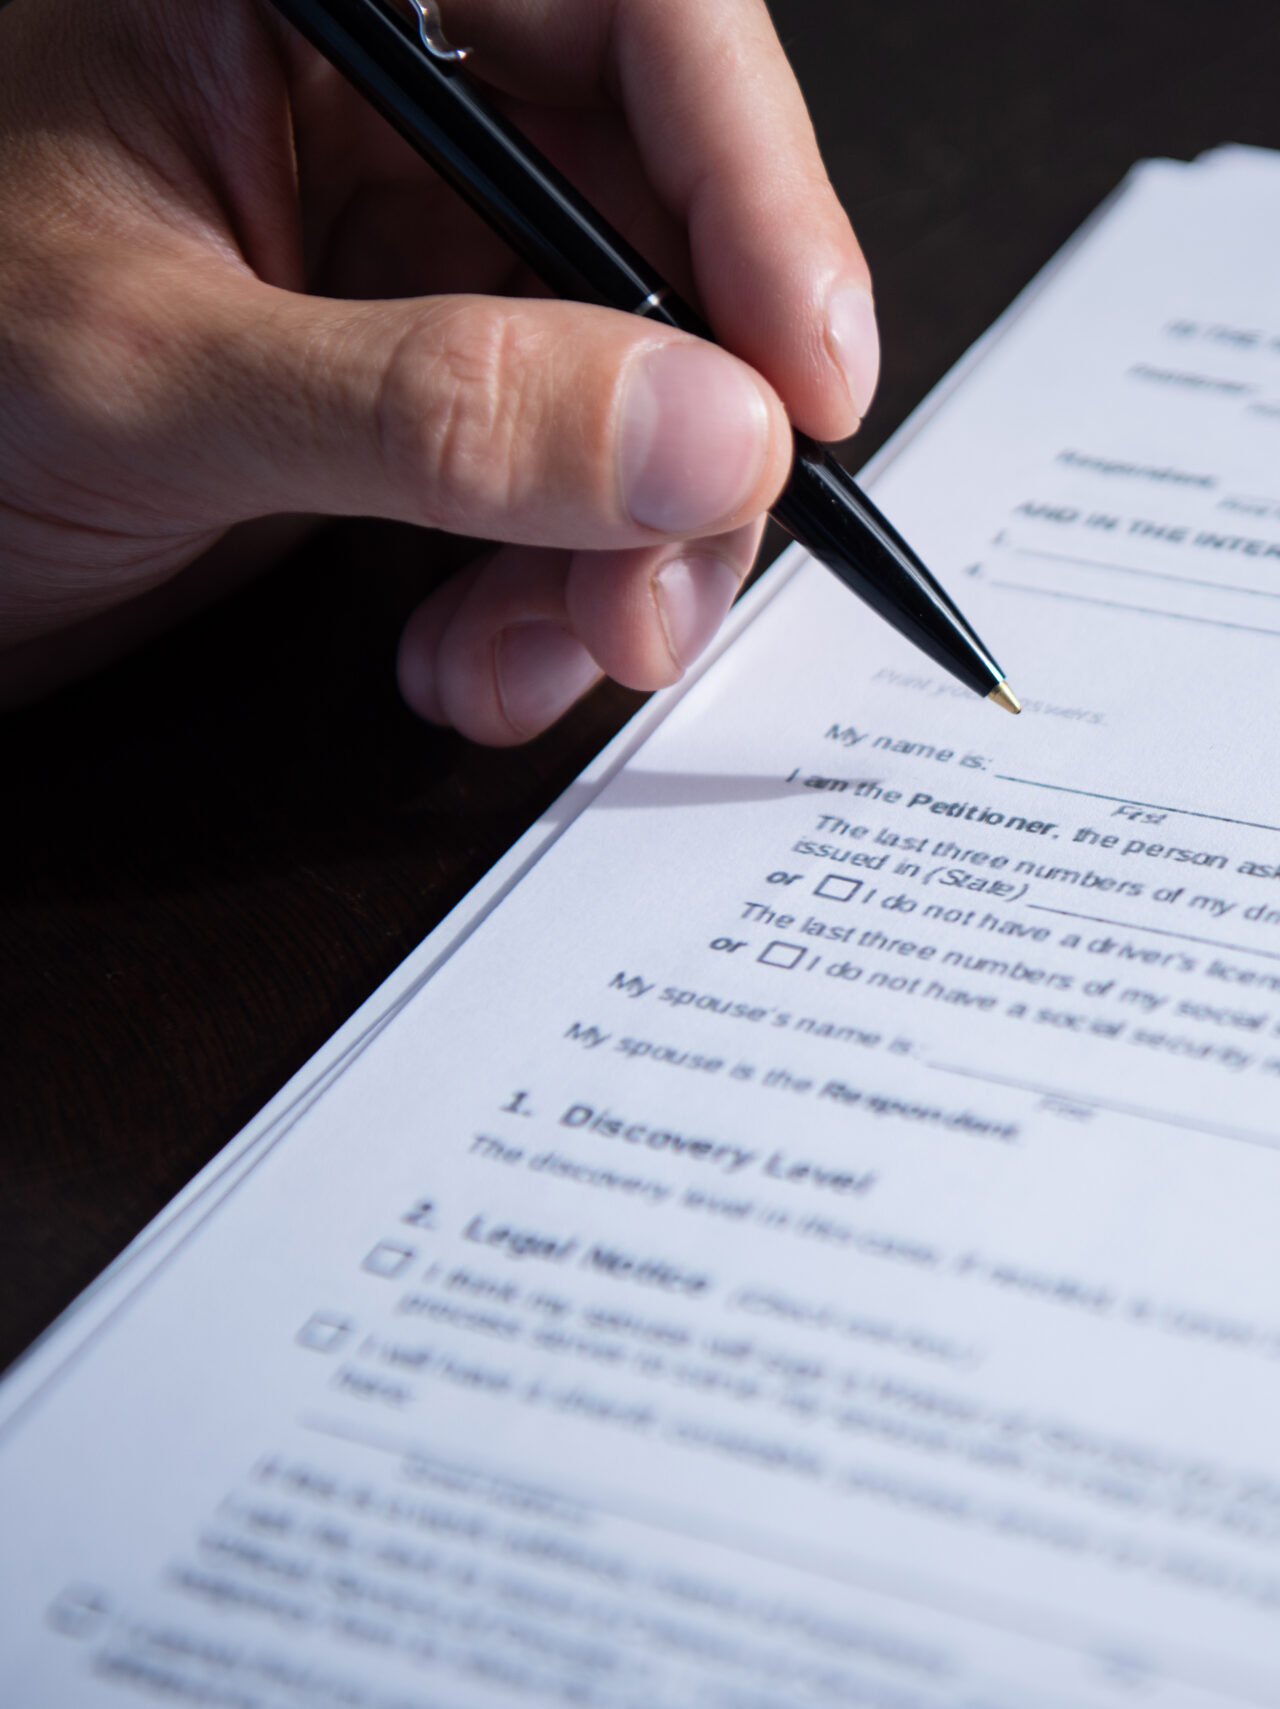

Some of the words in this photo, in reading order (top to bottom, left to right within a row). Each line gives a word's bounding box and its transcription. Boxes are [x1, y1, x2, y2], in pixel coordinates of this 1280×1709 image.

[1013, 500, 1079, 525] AND
[1084, 509, 1119, 533] IN
[1126, 517, 1189, 544] THE
[823, 722, 869, 748] My
[871, 735, 956, 764] name
[958, 750, 996, 772] is:
[784, 768, 802, 784] I
[802, 776, 849, 794] am
[853, 780, 902, 803] the
[1071, 826, 1121, 849] the
[1119, 839, 1231, 872] person
[1110, 804, 1168, 826] First
[790, 839, 888, 870] issued
[892, 858, 922, 879] in
[921, 866, 1031, 900] (State)
[814, 813, 869, 841] The
[873, 827, 930, 854] last
[931, 839, 1011, 871] three
[1013, 857, 1144, 895] numbers
[1151, 882, 1185, 906] of
[1187, 894, 1239, 919] my
[764, 870, 804, 887] or
[861, 889, 879, 904] I
[879, 894, 918, 915] do
[921, 903, 979, 929] not
[977, 912, 1052, 943] have
[1059, 933, 1082, 949] a
[1085, 934, 1199, 975] driver's
[707, 936, 749, 954] or
[805, 956, 823, 972] I
[825, 960, 864, 982] do
[866, 970, 923, 996] not
[922, 980, 1000, 1012] have
[1005, 1001, 1030, 1019] a
[1033, 1008, 1127, 1038] social
[1130, 1028, 1252, 1072] security
[740, 901, 795, 931] The
[799, 916, 857, 943] last
[856, 931, 938, 962] three
[941, 946, 1075, 993] numbers
[1080, 978, 1116, 999] of
[1118, 987, 1170, 1014] my
[1175, 999, 1269, 1033] social
[606, 970, 655, 998] My
[657, 982, 793, 1028] spouse's
[793, 1015, 883, 1048] name
[562, 1020, 611, 1050] My
[613, 1033, 726, 1074] spouse
[727, 1063, 756, 1083] is
[761, 1067, 814, 1095] the
[468, 1133, 524, 1164] The
[500, 1088, 534, 1119] 1.
[558, 1101, 758, 1175] Discovery
[761, 1149, 877, 1197] Level
[402, 1198, 440, 1231] 2.
[459, 1213, 579, 1269] Legal
